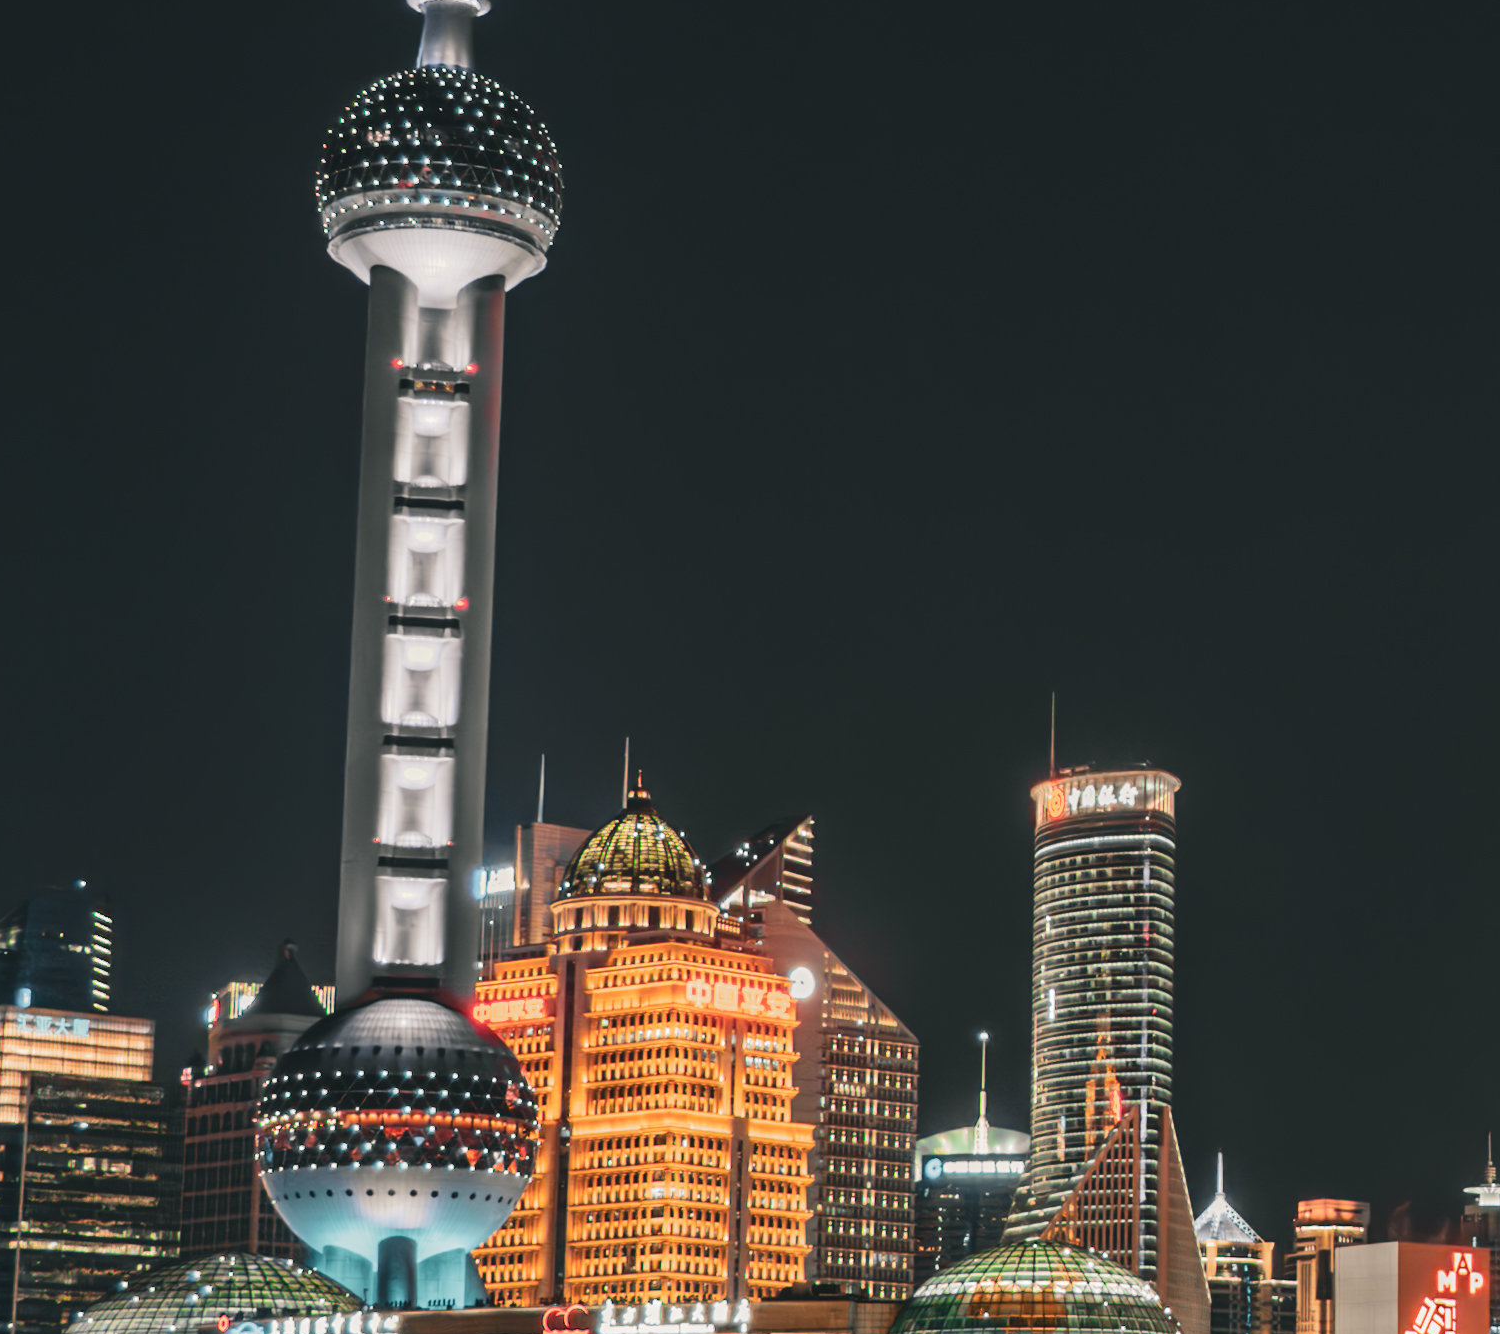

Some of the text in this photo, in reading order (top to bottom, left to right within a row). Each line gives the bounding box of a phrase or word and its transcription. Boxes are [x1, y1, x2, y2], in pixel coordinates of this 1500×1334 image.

[1067, 782, 1139, 812] 中国银行
[472, 997, 544, 1024] 中国平安
[685, 978, 792, 1020] 中国平安
[1437, 1252, 1484, 1294] MAP
